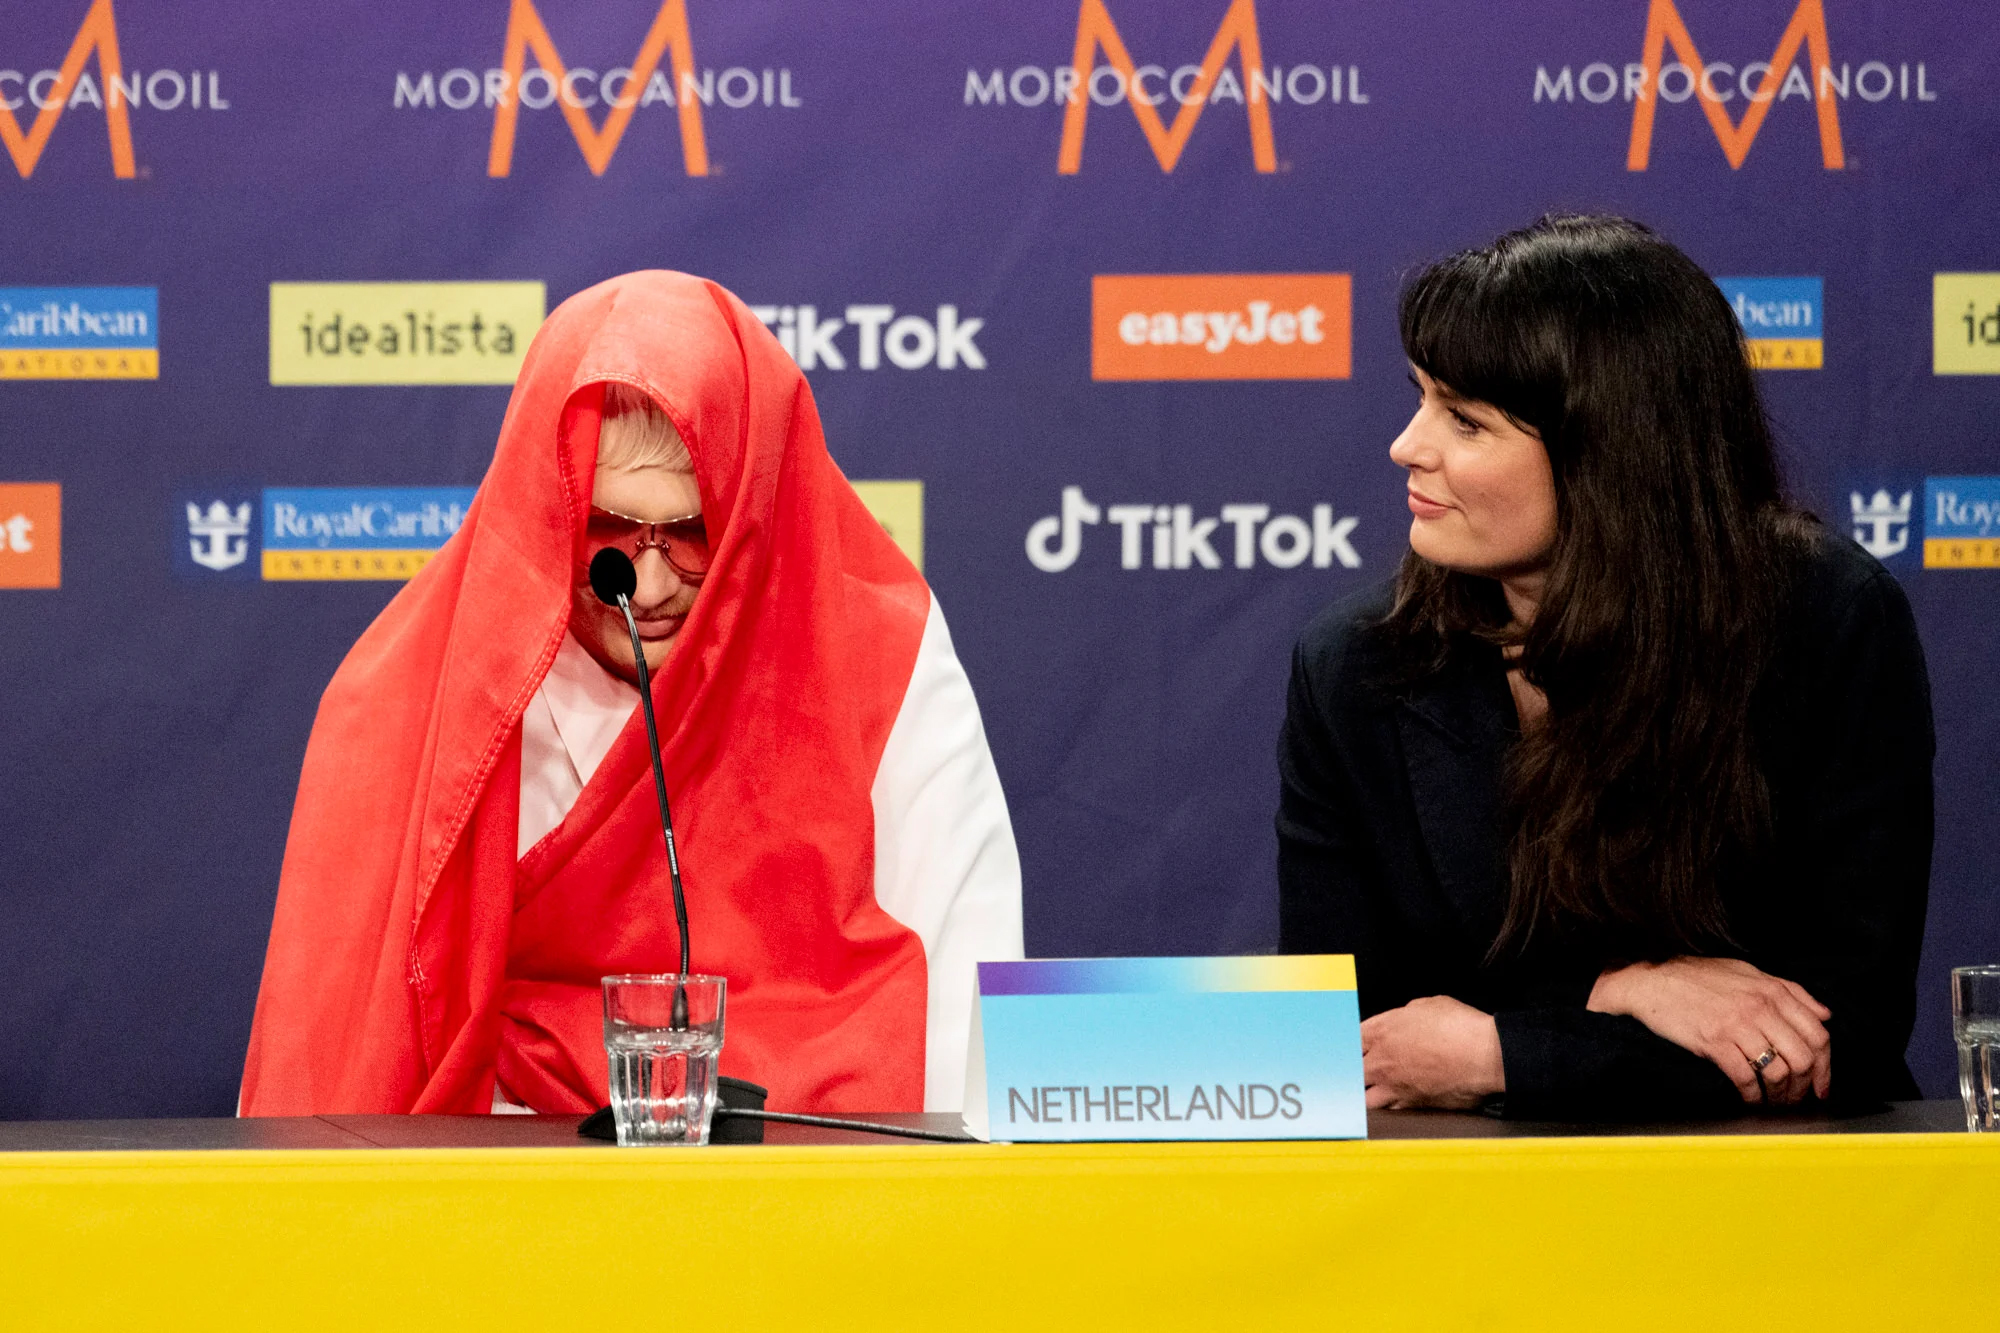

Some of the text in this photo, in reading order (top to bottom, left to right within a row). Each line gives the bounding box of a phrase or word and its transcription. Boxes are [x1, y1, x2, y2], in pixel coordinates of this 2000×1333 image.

[394, 67, 801, 110] MOROCCANOIL
[488, 0, 709, 178] M
[964, 64, 1369, 106] MOROCCANOIL
[1058, 0, 1277, 175] M
[1534, 61, 1937, 103] MOROCCANOIL
[1627, 0, 1845, 172] M
[301, 311, 515, 356] idealista
[1118, 300, 1324, 353] easyJet
[1107, 503, 1362, 570] TikTok
[1008, 1083, 1303, 1124] NETHERLANDS
